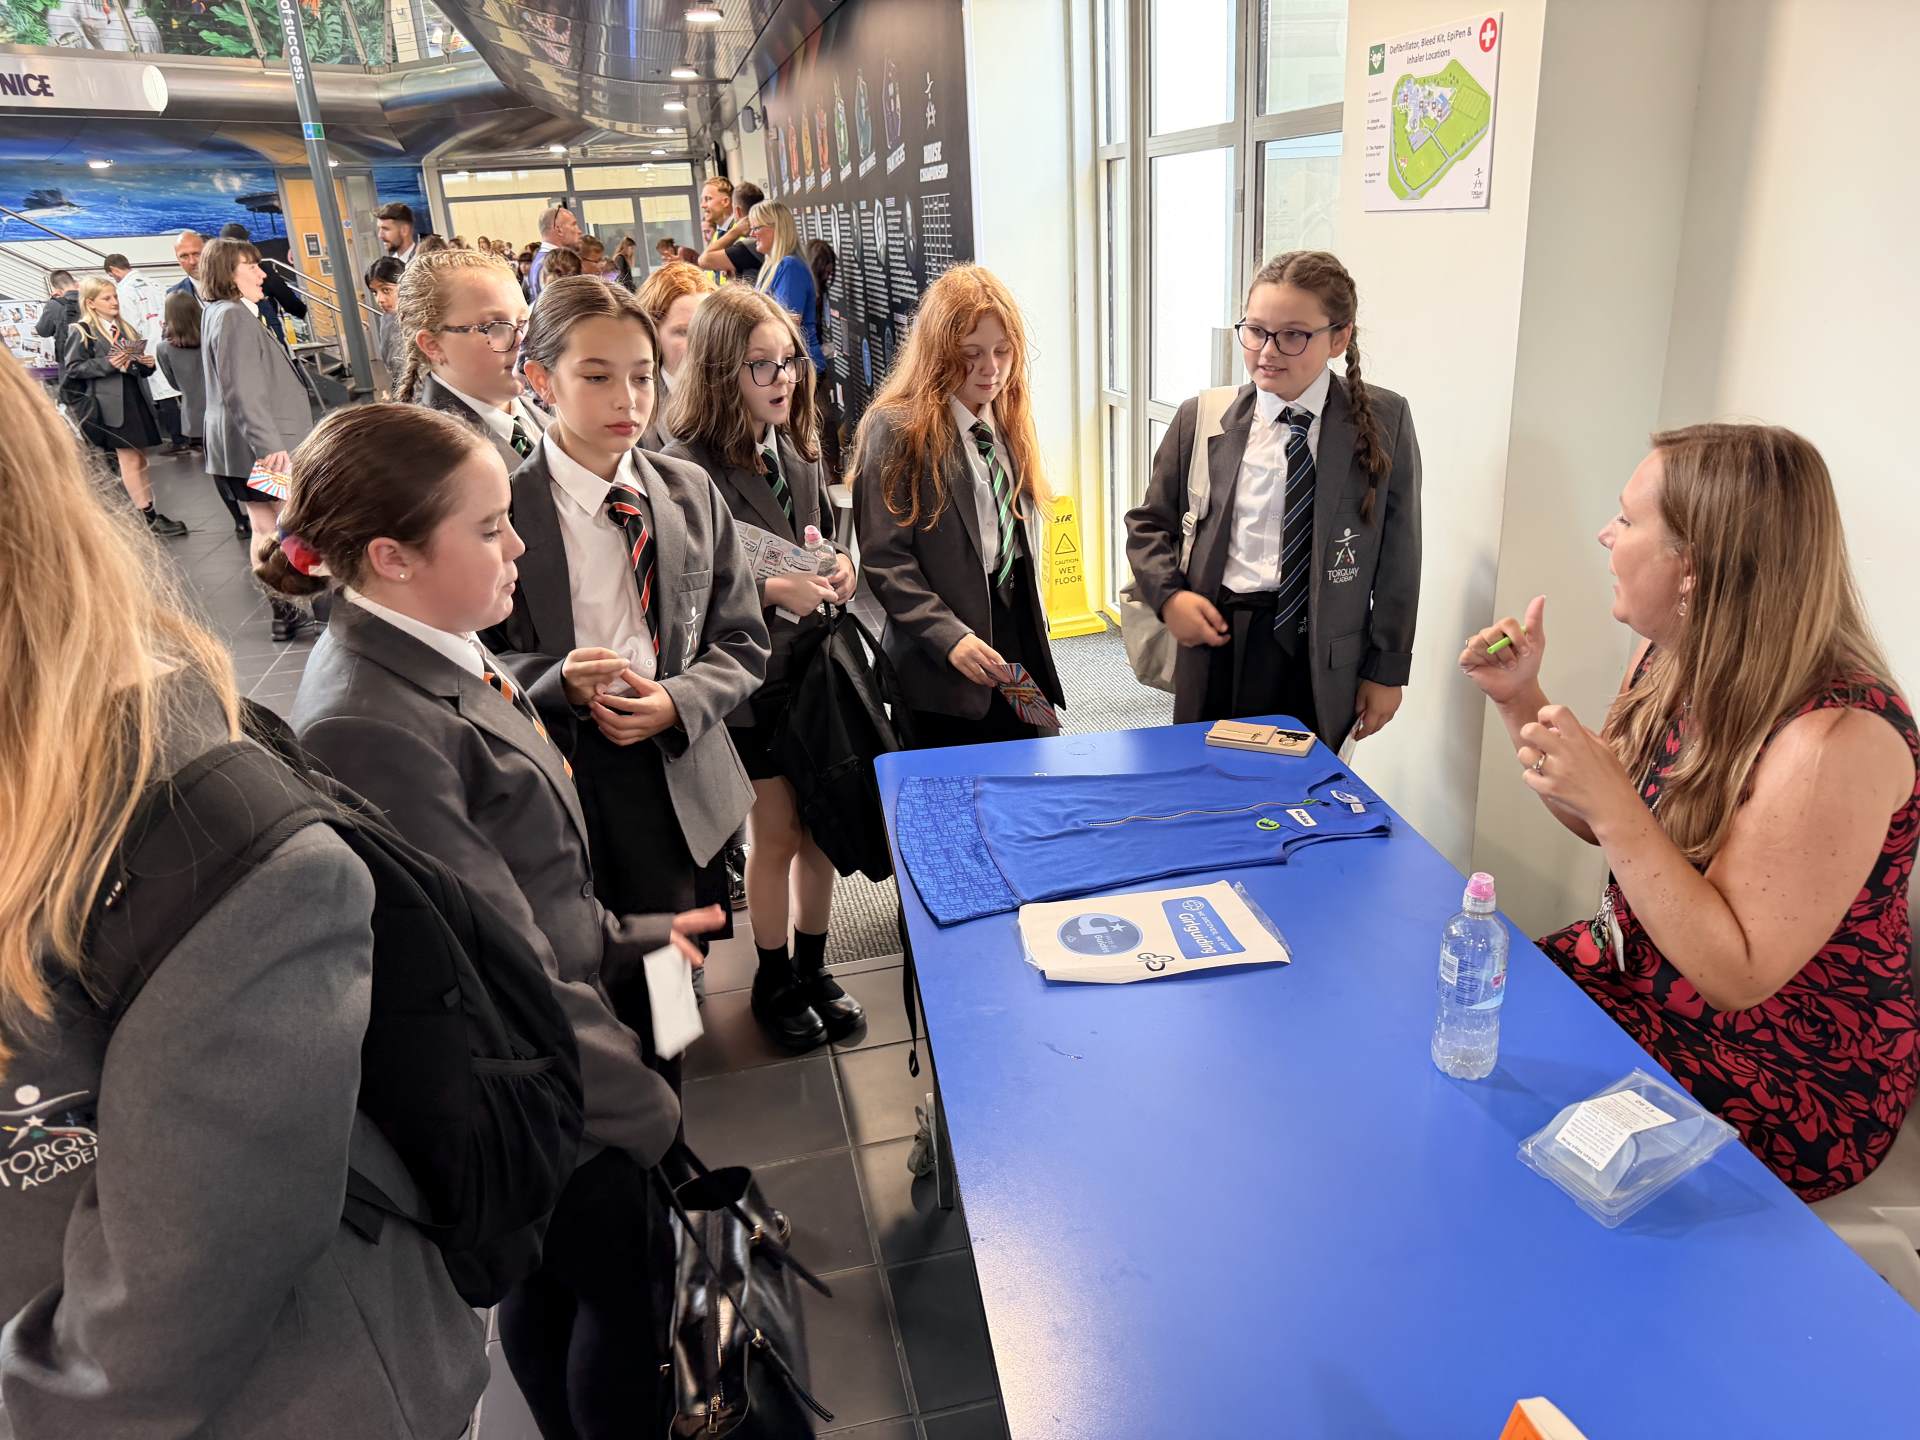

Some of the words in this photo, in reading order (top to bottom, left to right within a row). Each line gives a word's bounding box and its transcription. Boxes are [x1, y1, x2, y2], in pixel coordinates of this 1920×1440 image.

[280, 0, 296, 14] of
[1389, 41, 1420, 54] Defibrillator,
[1420, 34, 1436, 47] Bleed
[1447, 30, 1466, 42] EpiPen
[1467, 26, 1472, 36] &
[284, 19, 306, 84] success.
[1406, 54, 1425, 64] Inhaler
[1426, 49, 1450, 61] Locations
[1058, 566, 1076, 574] WET
[1328, 566, 1360, 580] TORQUAY
[1054, 575, 1082, 586] FLOOR
[1332, 576, 1354, 584] ACADEMY
[1178, 913, 1217, 954] Girlguiding
[0, 1136, 98, 1187] TORQU
[22, 1146, 98, 1190] ACADE
